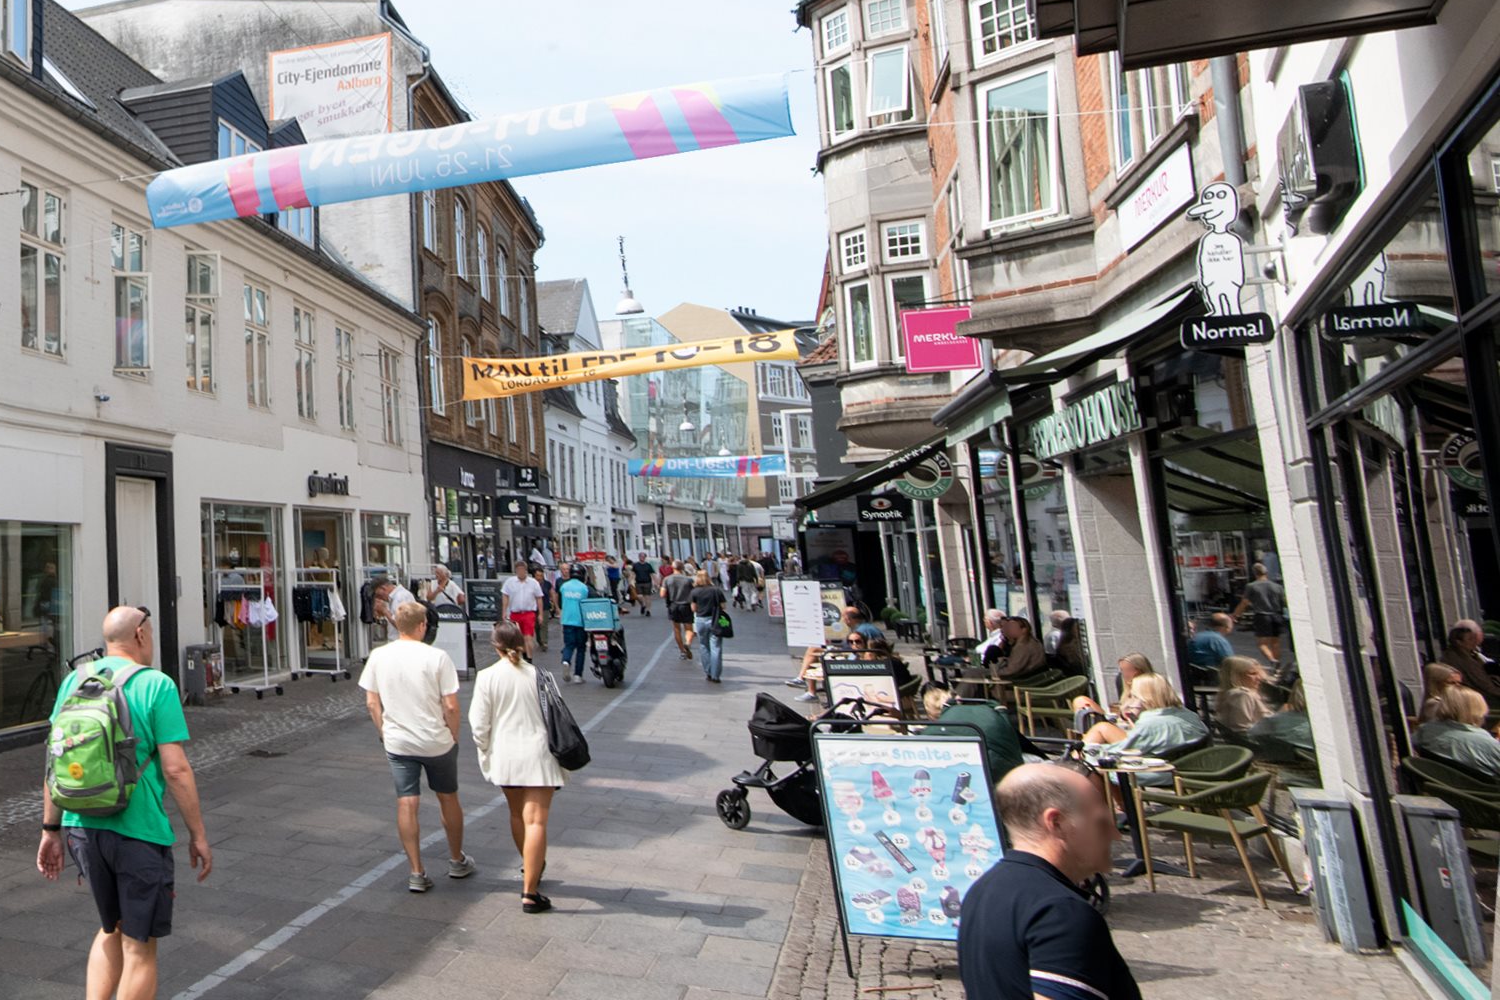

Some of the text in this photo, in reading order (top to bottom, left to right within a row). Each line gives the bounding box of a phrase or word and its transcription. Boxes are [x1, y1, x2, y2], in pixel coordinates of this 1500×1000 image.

[1192, 319, 1264, 341] Normal
[903, 482, 946, 497] HOUSE
[861, 509, 903, 520] Synoptik
